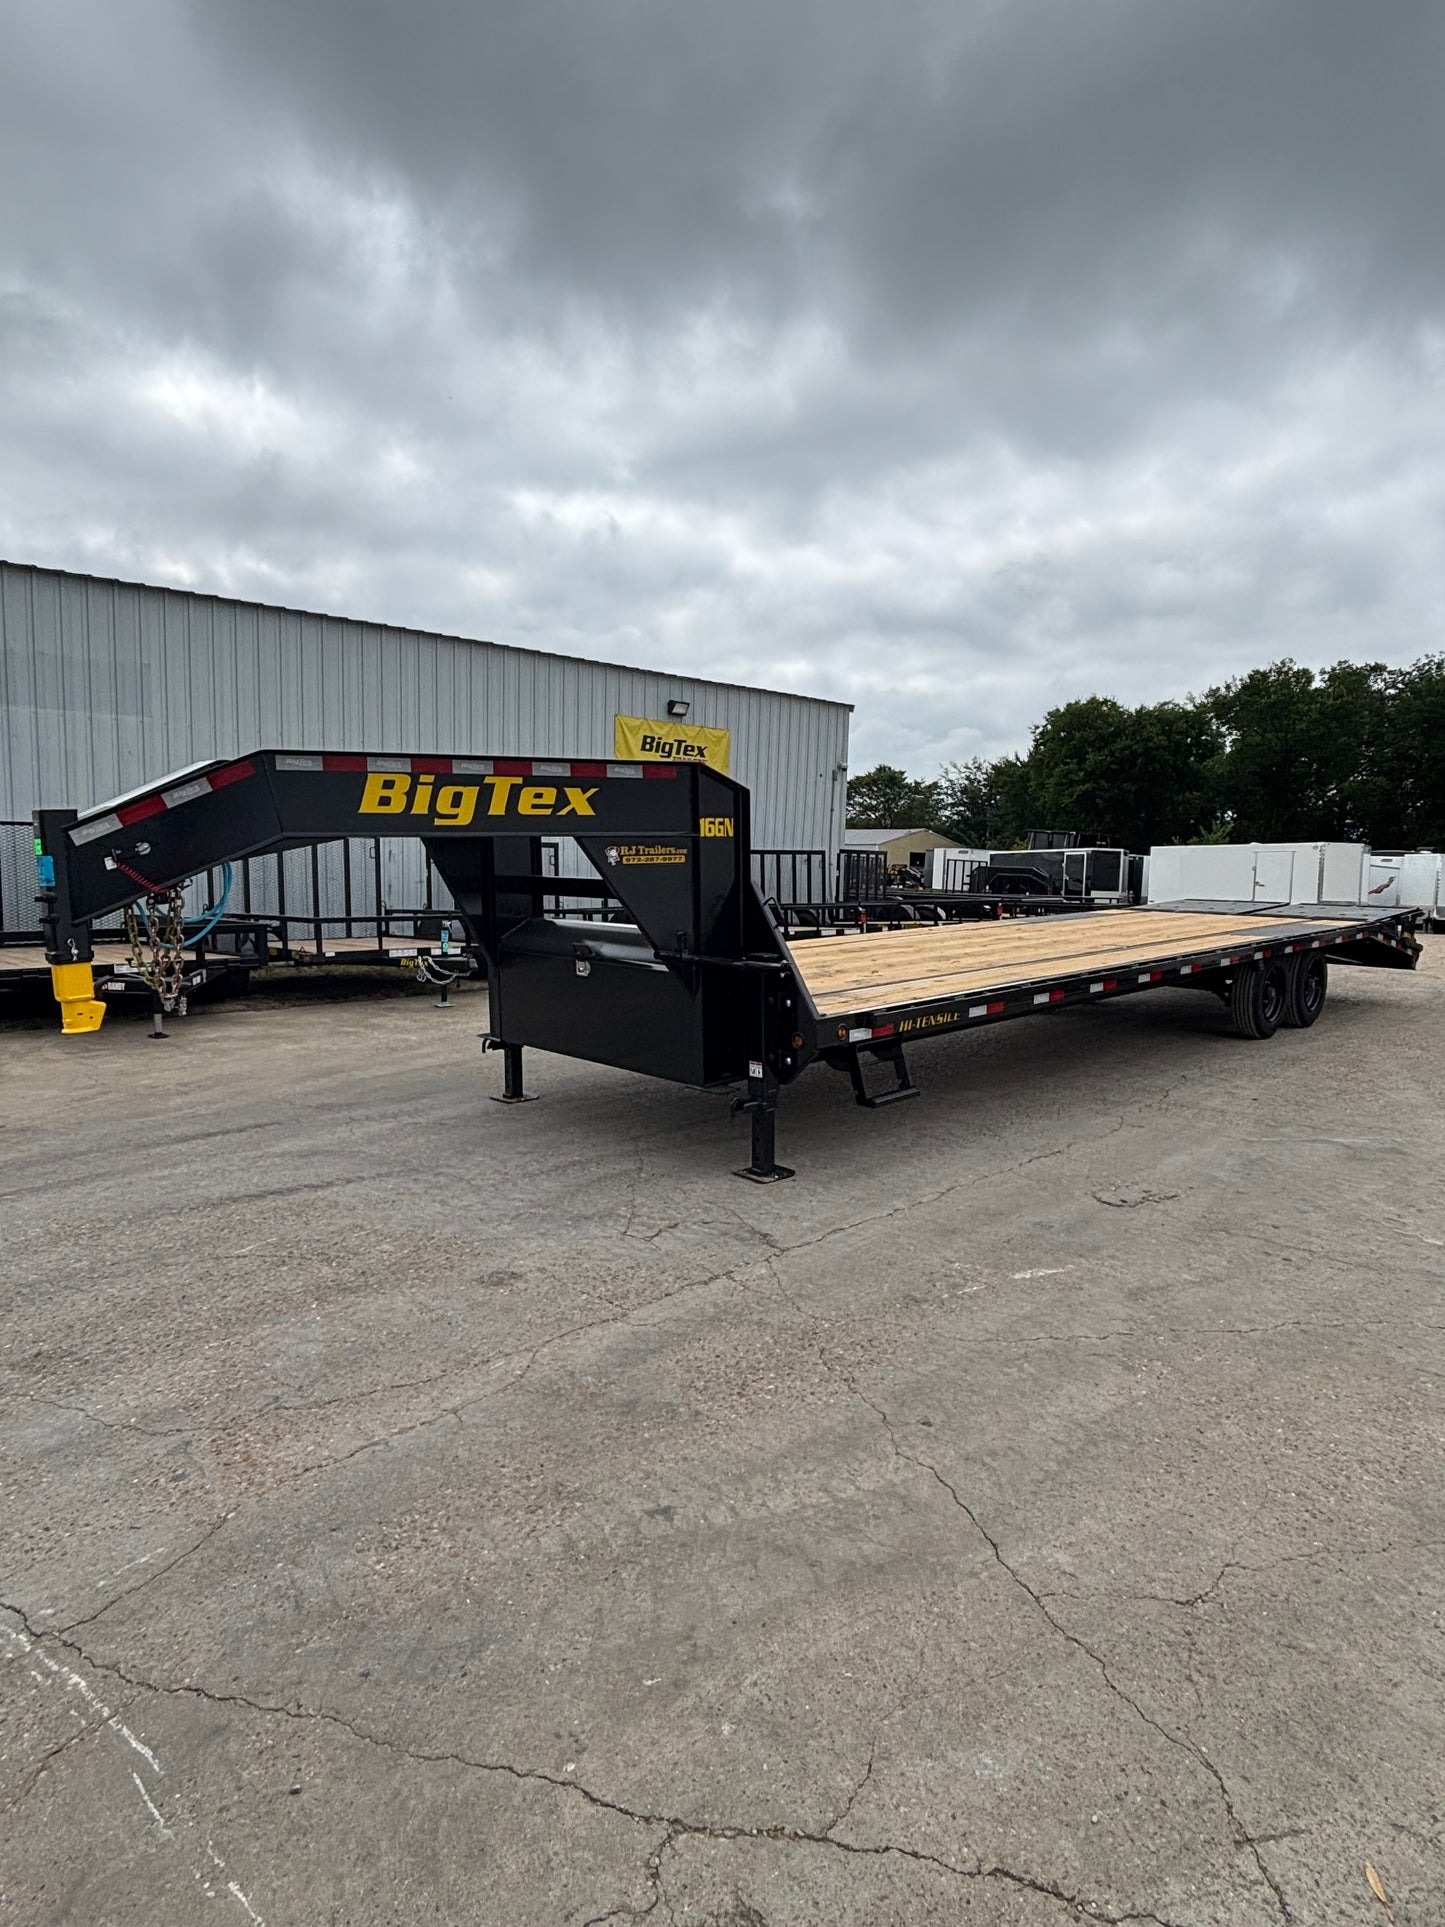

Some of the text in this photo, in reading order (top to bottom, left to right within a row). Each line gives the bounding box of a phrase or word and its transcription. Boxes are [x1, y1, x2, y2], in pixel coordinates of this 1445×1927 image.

[640, 735, 708, 758] BigTex
[358, 773, 599, 826] BigTex
[699, 818, 733, 837] 16GN
[620, 846, 637, 855] RJ
